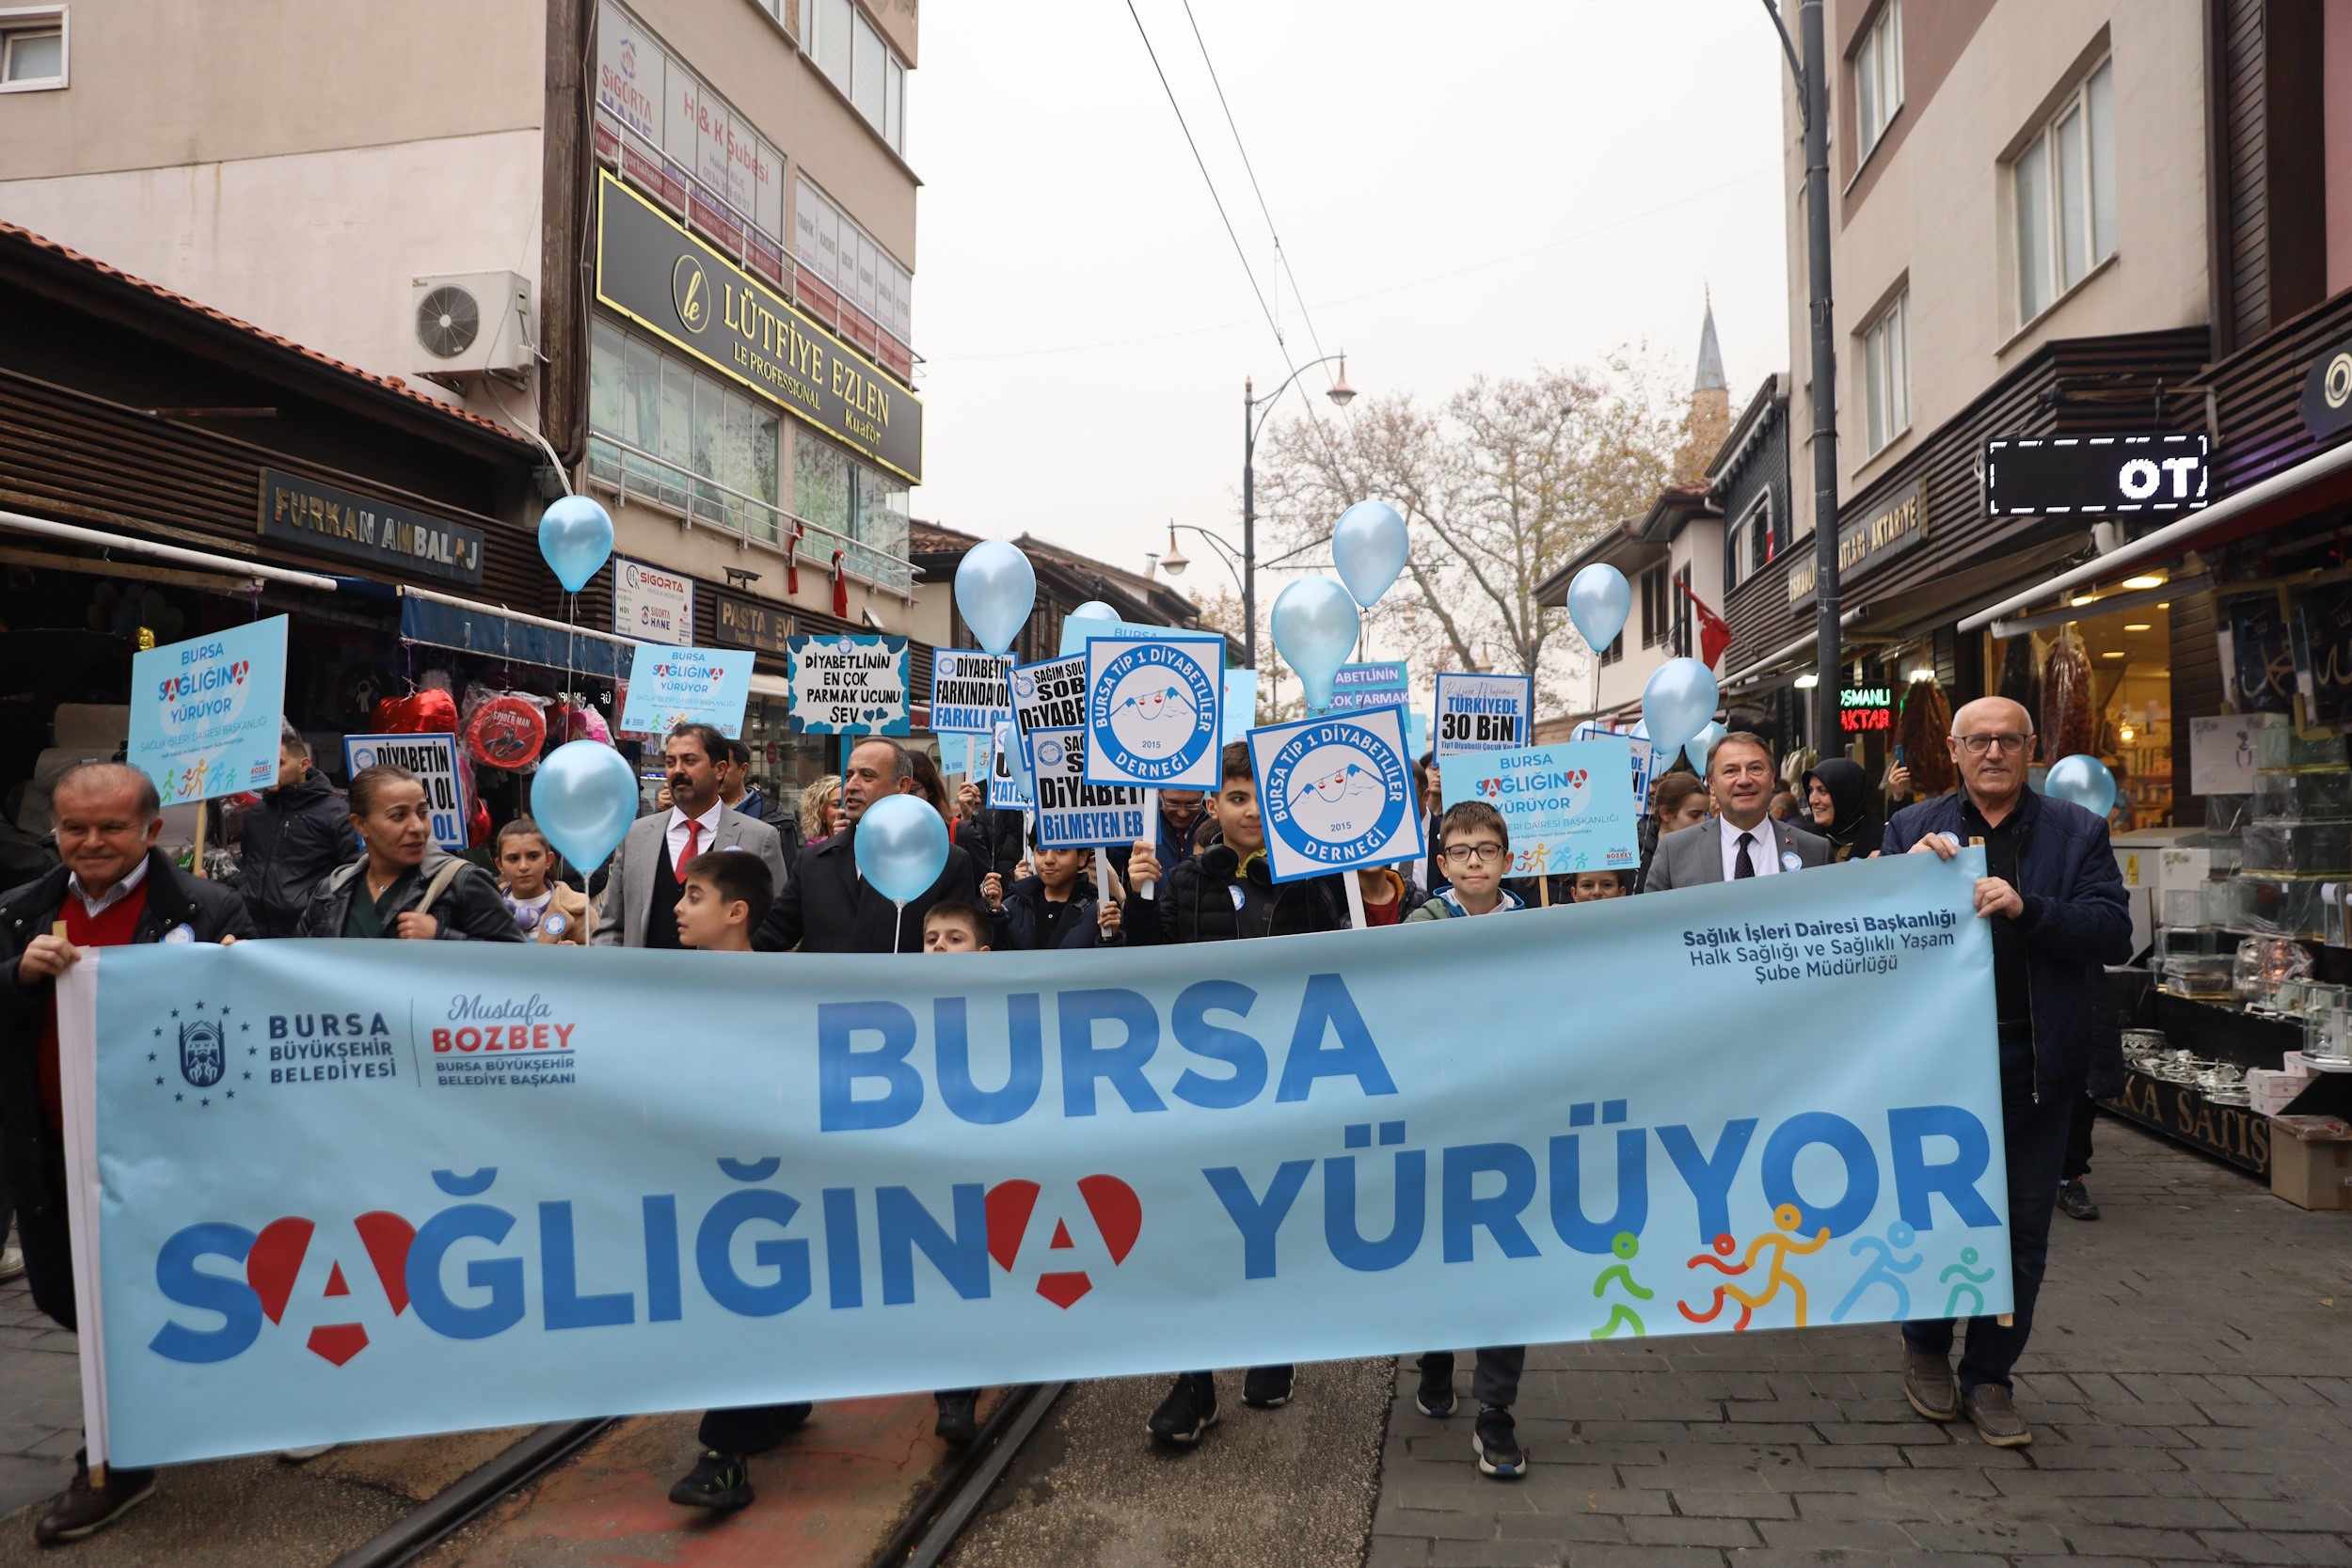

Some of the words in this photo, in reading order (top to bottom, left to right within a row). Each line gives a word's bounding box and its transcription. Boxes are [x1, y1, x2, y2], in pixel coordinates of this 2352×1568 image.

[684, 90, 694, 120] H
[700, 105, 710, 135] &
[714, 119, 723, 147] K
[727, 132, 770, 186] Şubesi
[723, 283, 823, 385] LÜTFİYE
[832, 357, 890, 427] EZLEN
[734, 341, 747, 365] LE
[750, 351, 821, 410] PROFESSIONAL
[2119, 457, 2207, 499] OT
[275, 486, 374, 545] FURKAN
[381, 517, 478, 571] AMBALAJ
[723, 602, 767, 634] PASTA
[182, 642, 224, 665] BURSA
[672, 652, 705, 661] BURSA
[805, 652, 890, 670] DİYABETLİNİN
[158, 659, 249, 702] SAĞLIĞINA
[652, 664, 723, 680] SAĞLIĞINA
[824, 673, 839, 686] EN
[843, 672, 868, 689] ÇOK
[957, 655, 1011, 680] DİYABETİN
[1035, 666, 1064, 684] SAĞIM
[1066, 660, 1086, 678] SOLU
[1336, 667, 1399, 684] ABETLİNİN
[660, 681, 708, 692] YÜRÜYOR
[807, 689, 857, 704] PARMAK
[861, 689, 900, 704] UCUNU
[936, 680, 993, 705] FARKINDA
[996, 683, 1009, 706] OL
[1037, 677, 1085, 702] SOB
[1095, 676, 1116, 728] BURSA
[1111, 657, 1133, 676] TİP
[1136, 651, 1146, 663] 1
[1151, 646, 1214, 732] DİYABETLİLER
[1356, 691, 1409, 705] PARMAK
[171, 697, 231, 723] YÜRÜYOR
[830, 706, 859, 723] SEV
[1448, 694, 1518, 714] TÜRKİYEDE
[493, 710, 531, 727] SPIDER-MAN
[935, 707, 986, 728] FARKLI
[1442, 713, 1470, 740] 30
[377, 741, 450, 772] DİYABETİN
[1454, 741, 1482, 750] Diyabetli
[1483, 742, 1502, 751] Çocuk
[1116, 752, 1189, 777] DERNEĞİ
[1271, 768, 1289, 823] BURSA
[1280, 741, 1304, 764] TİP
[1307, 735, 1318, 747] 1
[1321, 724, 1403, 801] DİYABETLİLER
[1500, 753, 1553, 769] BURSA
[436, 777, 455, 810] OL
[1475, 769, 1587, 798] SAĞLIĞINA
[1494, 798, 1570, 815] YÜRÜYOR
[434, 814, 457, 840] OL
[1124, 811, 1144, 837] EB
[1330, 822, 1352, 832] 2015
[1508, 821, 1522, 831] ERİ
[1525, 818, 1561, 830] DAİRESİ
[1564, 814, 1619, 827] BAŞKANLIĞI
[1303, 827, 1387, 861] DERNEĞİ
[1683, 927, 1741, 948] Sağlık
[1747, 922, 1790, 943] İşleri
[1795, 917, 1859, 938] Dairesi
[1863, 909, 1956, 932] Başkanlığı
[1691, 946, 1731, 966] Halk
[1737, 942, 1798, 964] Sağlığı
[1804, 943, 1825, 957] ve
[1832, 935, 1895, 957] Sağlıklı
[1899, 931, 1955, 950] Yaşam
[1755, 962, 1801, 985] Şube
[1806, 956, 1898, 977] Müdürlüğü
[448, 993, 552, 1026] Mustafa
[269, 1012, 391, 1039] BURSA
[432, 1023, 576, 1053] BOZBEY
[270, 1037, 393, 1062] BÜYÜKŞEHİR
[818, 973, 1399, 1132] BURSA
[270, 1059, 396, 1084] BELEDİYESİ
[436, 1060, 482, 1072] BURSA
[485, 1055, 575, 1073] BÜYÜKŞEHİR
[438, 1072, 509, 1086] BELEDİYE
[511, 1072, 576, 1088] BAŞKANI
[2177, 1090, 2270, 1173] SATIŞ
[149, 1156, 1142, 1368] SAĞLIĞINA
[1201, 1098, 2003, 1280] YÜRÜYOR
